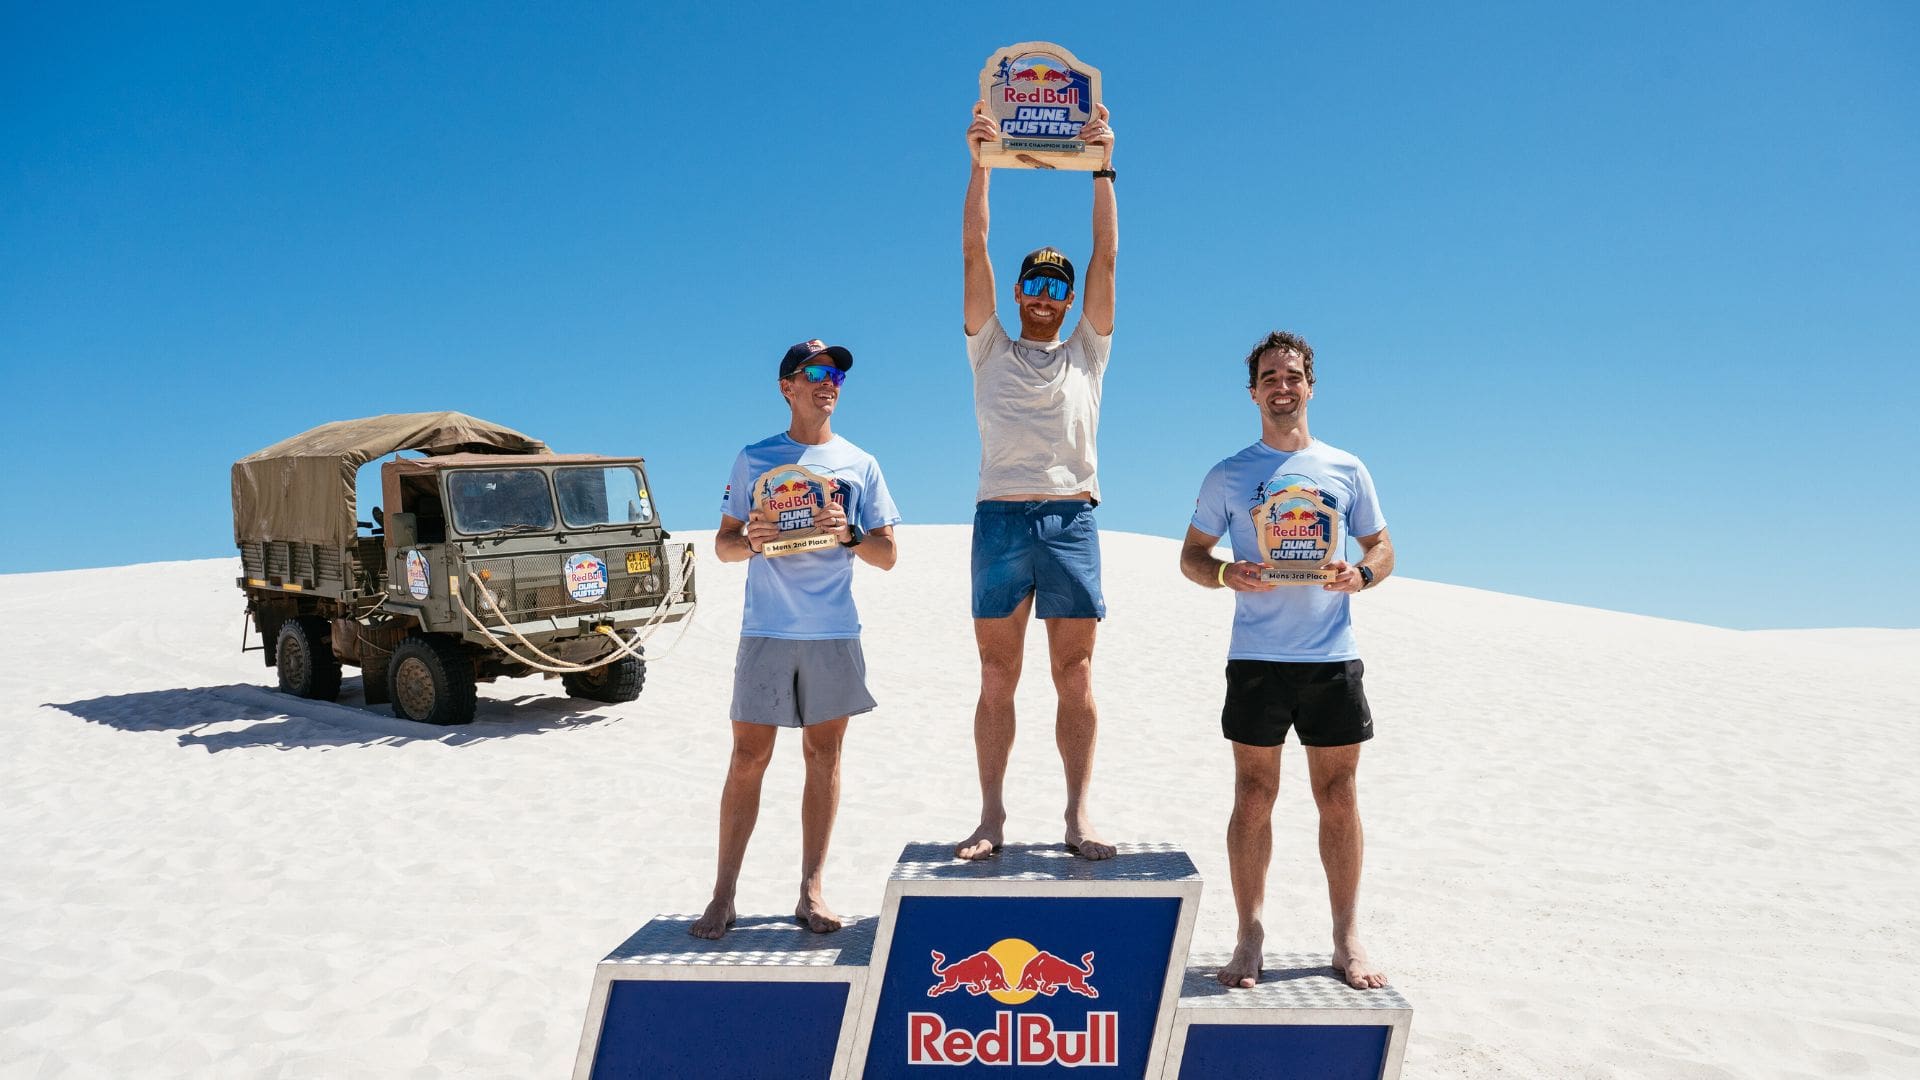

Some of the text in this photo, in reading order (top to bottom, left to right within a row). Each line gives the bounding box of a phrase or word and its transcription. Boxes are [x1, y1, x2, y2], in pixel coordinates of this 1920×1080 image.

[1004, 87, 1079, 105] Red Bull
[1018, 107, 1067, 121] DUNE
[1002, 120, 1083, 135] DUSTERS
[1034, 250, 1065, 267] JUST
[769, 492, 817, 510] Red Bull
[780, 508, 811, 521] DUNE
[1273, 524, 1323, 537] Red Bull
[808, 538, 828, 546] Place
[1282, 540, 1315, 550] DUNE
[1271, 549, 1326, 559] DUSTERS
[571, 571, 603, 582] Red Bull
[578, 582, 599, 590] DUNE
[909, 1012, 1118, 1066] Red Bull
